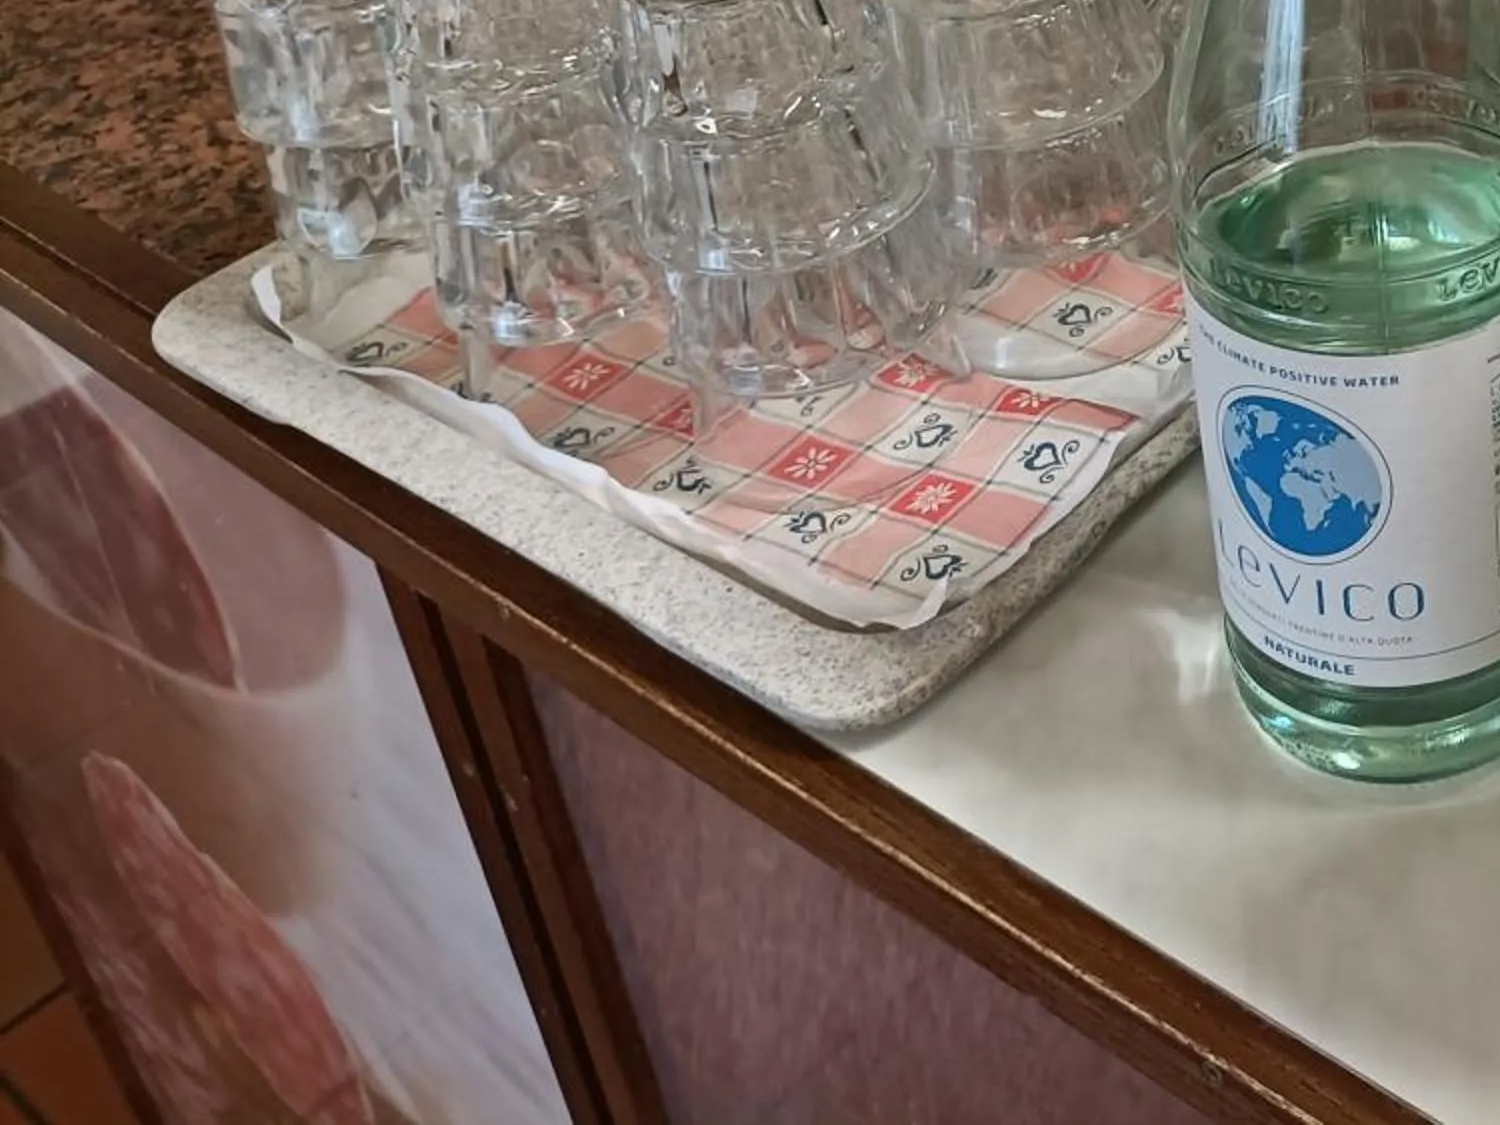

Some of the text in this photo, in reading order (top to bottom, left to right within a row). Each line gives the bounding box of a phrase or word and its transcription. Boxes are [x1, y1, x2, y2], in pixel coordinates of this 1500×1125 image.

[1217, 340, 1265, 373] CLIMATE
[1269, 366, 1338, 387] POSITIVE
[1343, 375, 1400, 388] WATER
[1263, 634, 1356, 676] NATURALE
